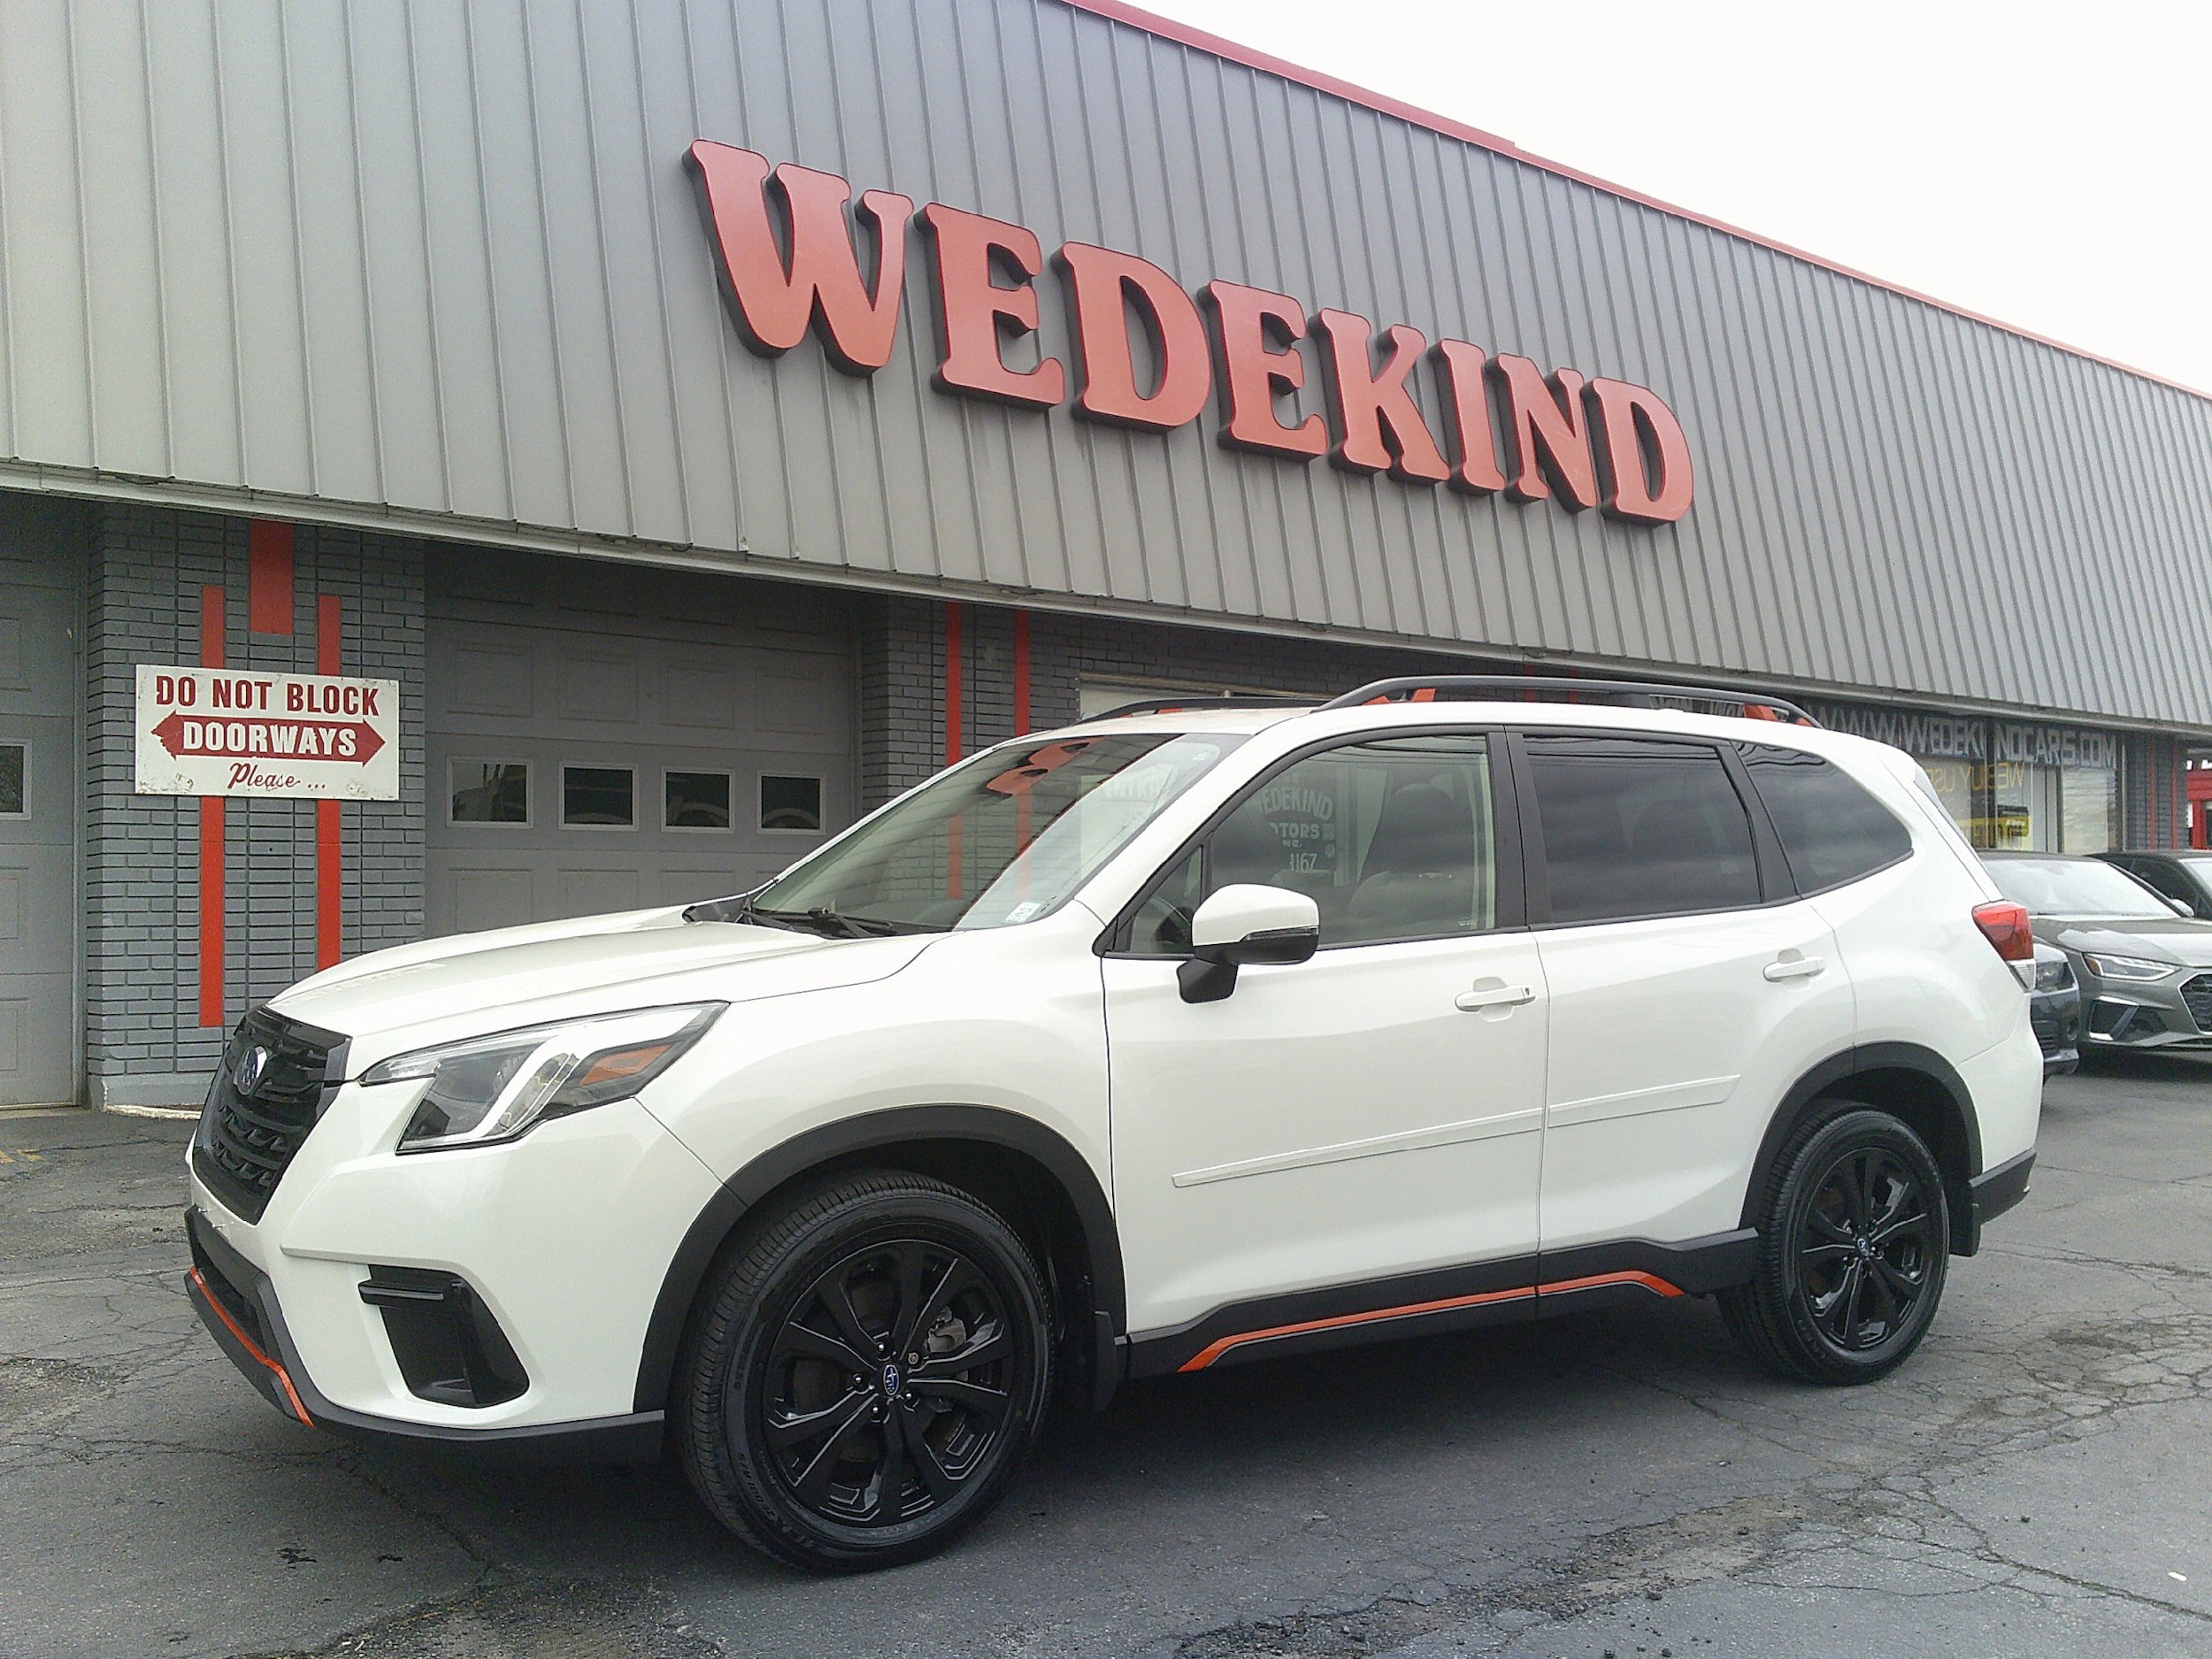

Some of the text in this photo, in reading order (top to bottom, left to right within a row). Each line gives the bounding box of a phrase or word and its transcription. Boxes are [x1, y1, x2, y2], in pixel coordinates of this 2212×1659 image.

[685, 139, 1694, 524] WEDEKIND
[156, 675, 380, 717] DO NOT BLOCK
[182, 720, 357, 757] DOORWAYS
[227, 762, 301, 790] Please
